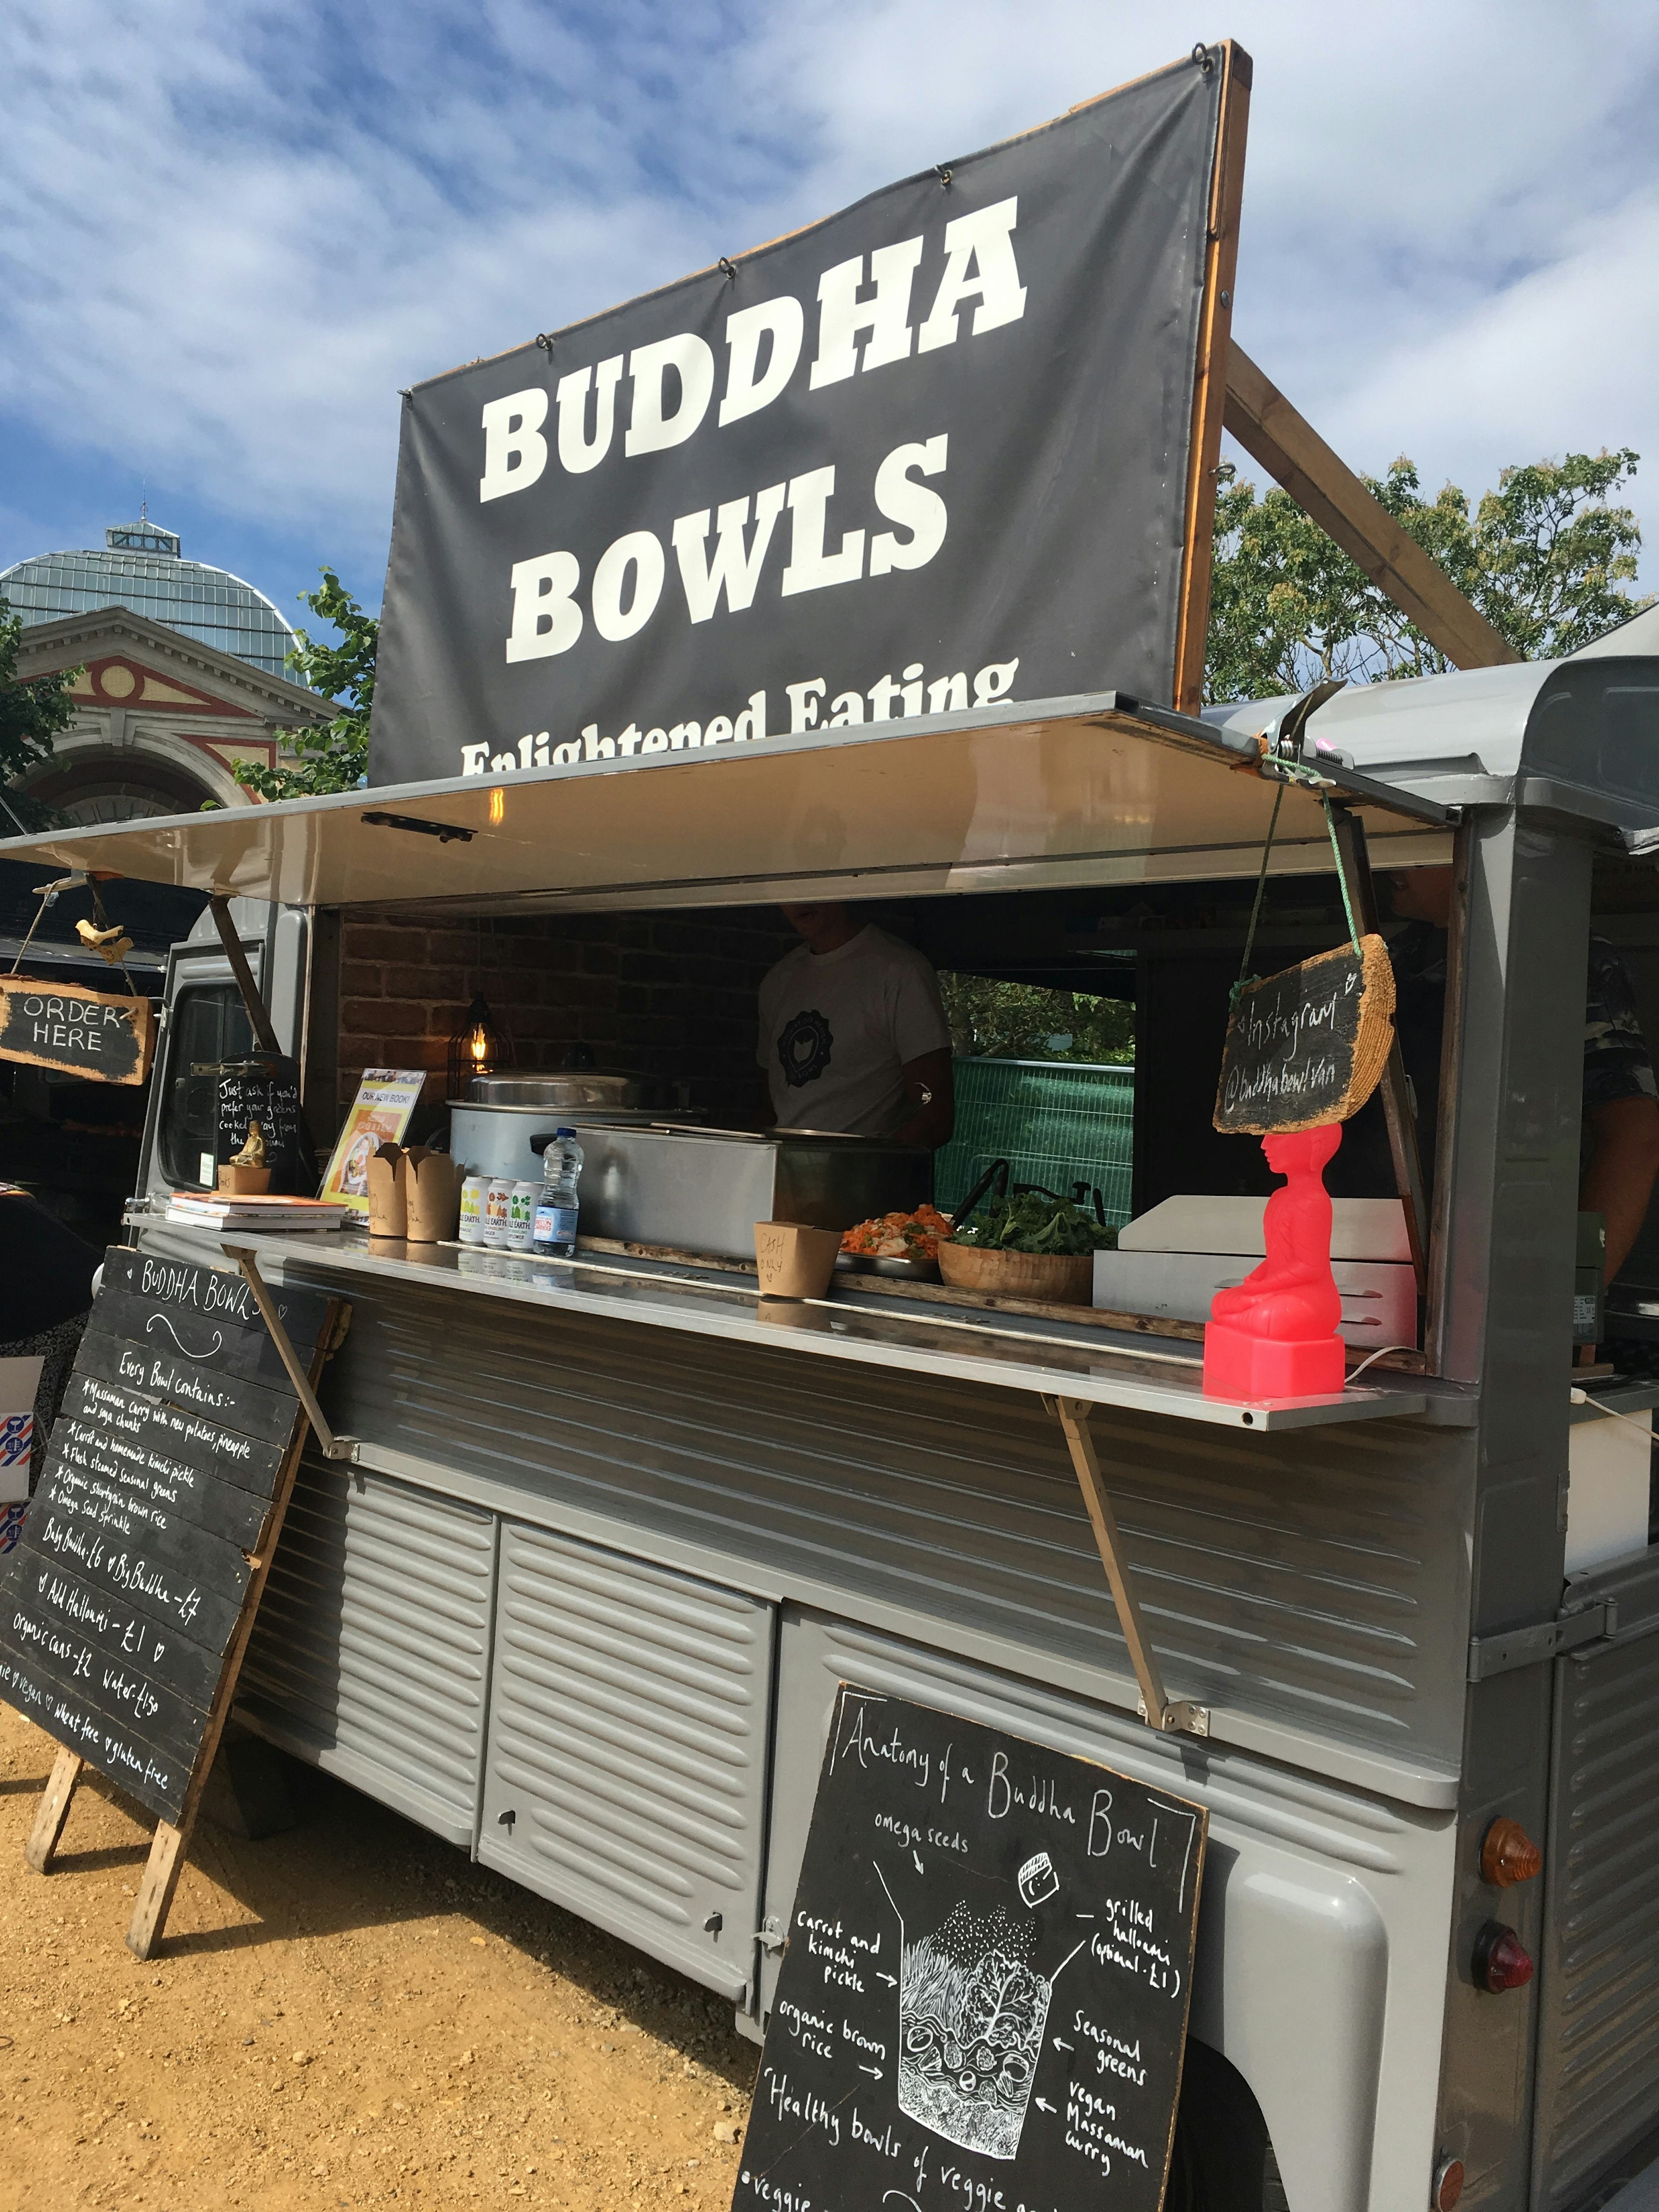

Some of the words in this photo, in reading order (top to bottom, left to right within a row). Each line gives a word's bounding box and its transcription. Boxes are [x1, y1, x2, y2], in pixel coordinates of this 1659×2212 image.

[480, 195, 1028, 503] BUDDHA
[505, 432, 949, 664] BOWLS
[24, 997, 120, 1028] ORDER
[33, 1022, 102, 1051] HERE
[219, 1078, 244, 1100] Just
[245, 1084, 263, 1097] ask
[267, 1081, 274, 1105] if
[362, 1092, 375, 1100] OUR
[375, 1093, 390, 1101] NEW
[389, 1094, 410, 1104] BOOK!
[219, 1117, 248, 1130] cooked
[221, 1100, 244, 1118] prefer
[246, 1103, 264, 1120] your
[230, 1132, 245, 1145] the
[760, 1233, 785, 1259] CASH
[142, 1260, 198, 1306] BUDDHA
[761, 1258, 782, 1273] ONLY
[120, 1352, 144, 1385] Every
[150, 1361, 175, 1390] Bowl
[83, 1402, 98, 1414] and
[89, 1382, 125, 1408] Massaman
[153, 1408, 168, 1425] with
[170, 1417, 184, 1431] new
[215, 1433, 250, 1459] pineapple
[70, 1447, 87, 1466] Flash
[90, 1453, 118, 1478] steamed
[151, 1481, 178, 1503] greens
[95, 1437, 108, 1450] and
[110, 1438, 145, 1465] homemade
[148, 1453, 172, 1475] kimchi
[169, 1465, 194, 1488] pickle
[58, 1490, 79, 1514] Omega
[128, 1497, 148, 1519] brown
[150, 1510, 167, 1529] rice
[42, 1517, 63, 1552] Baby
[113, 1553, 130, 1589] Big
[129, 1560, 170, 1603] Buddha
[47, 1577, 67, 1608] Add
[80, 1716, 99, 1743] free
[107, 1742, 143, 1773] gluten
[143, 1758, 168, 1790] free
[842, 1707, 929, 1787] Anatomy
[939, 1743, 953, 1803] of
[962, 1766, 975, 1784] a
[988, 1751, 1075, 1824] Buddha
[1087, 1789, 1157, 1868] Bowl
[874, 1814, 922, 1848] omega
[928, 1828, 968, 1853] seeds
[1106, 1899, 1153, 1933] grilled
[808, 1933, 857, 1969] kimchi
[850, 1932, 881, 1954] and
[1113, 1920, 1171, 1966] halloumi
[824, 1964, 864, 1993] pickle
[779, 2000, 833, 2037] organic
[842, 2019, 886, 2060] brown
[802, 2032, 833, 2059] rice
[1096, 2049, 1148, 2086] greens
[1069, 2081, 1116, 2121] vegan
[1067, 2101, 1149, 2169] Massaman
[852, 2107, 902, 2158] bowls
[914, 2145, 929, 2193] of
[941, 2166, 1006, 2212] veggie
[1065, 2130, 1111, 2177] curry
